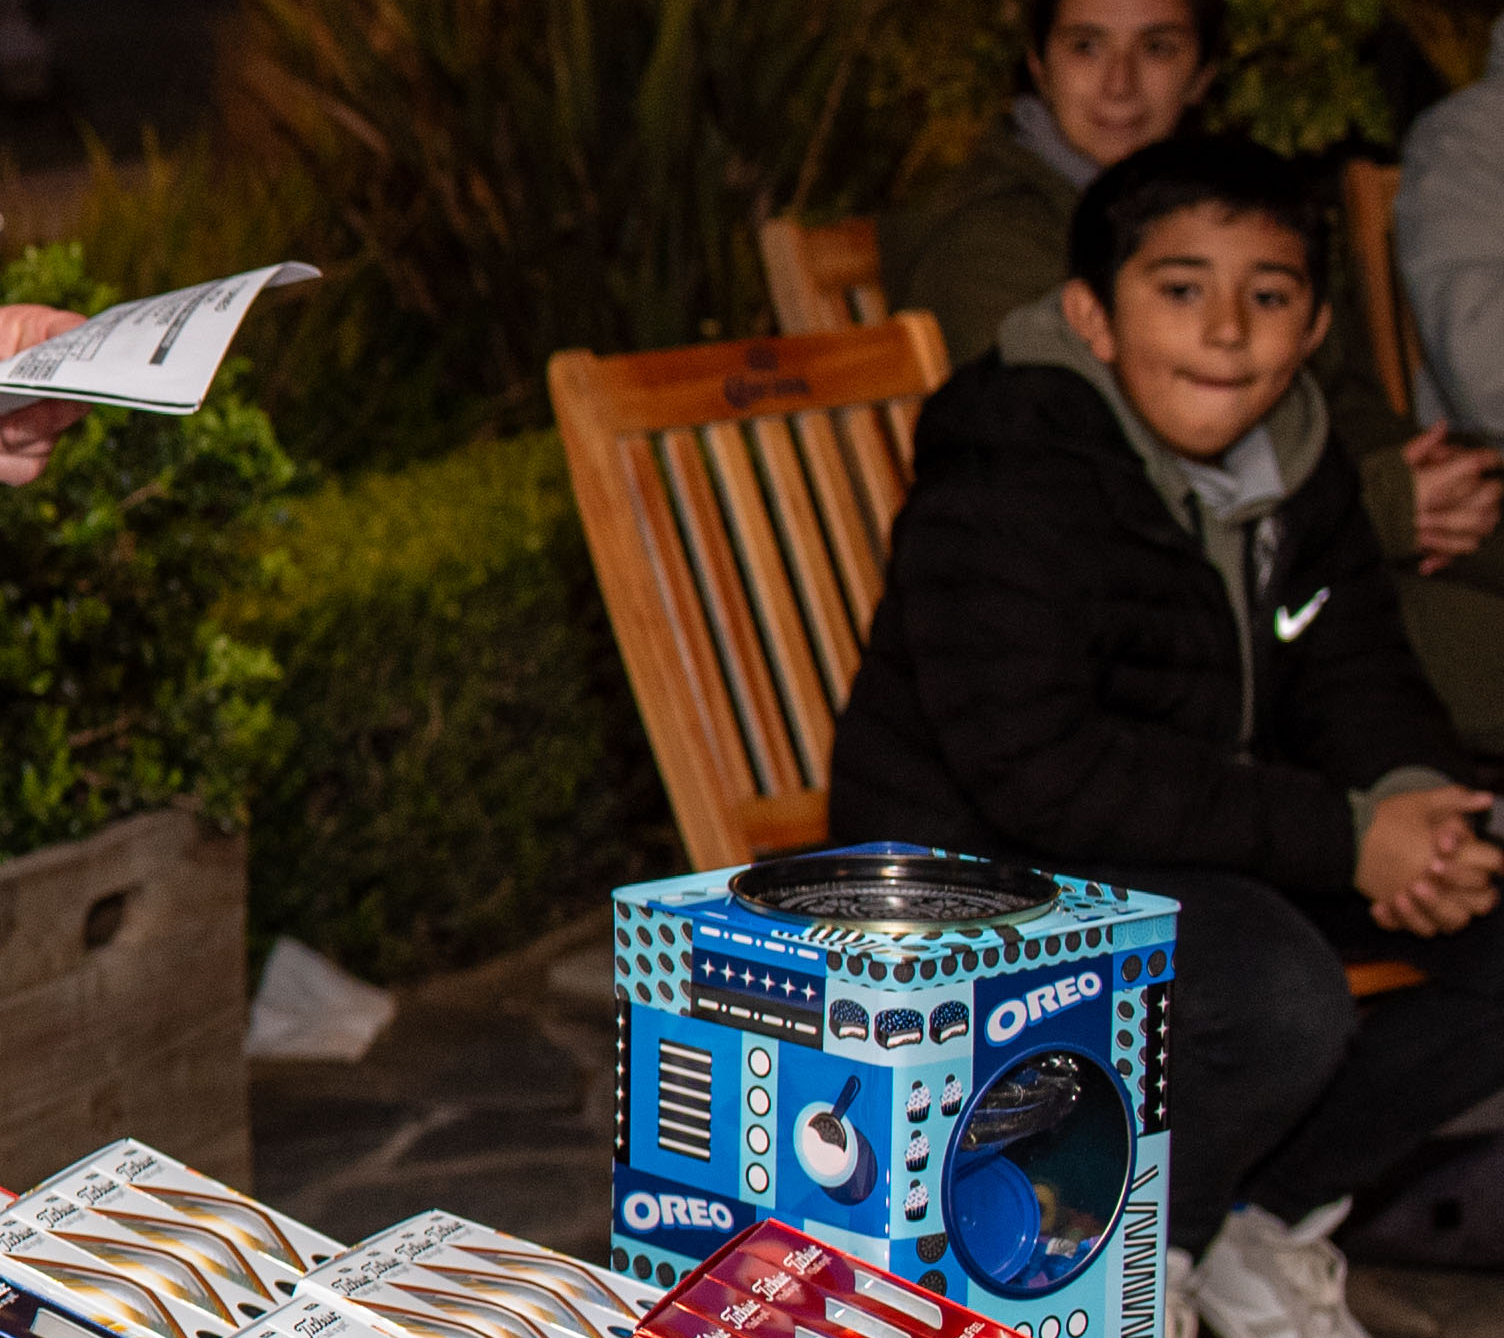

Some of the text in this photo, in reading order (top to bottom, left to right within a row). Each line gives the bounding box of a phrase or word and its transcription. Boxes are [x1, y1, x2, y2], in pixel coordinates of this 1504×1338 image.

[985, 970, 1102, 1048] OREO
[622, 1191, 734, 1232] OREO
[784, 1244, 823, 1275] Titleist
[752, 1271, 791, 1302] Titleist
[721, 1299, 761, 1330] Titleist
